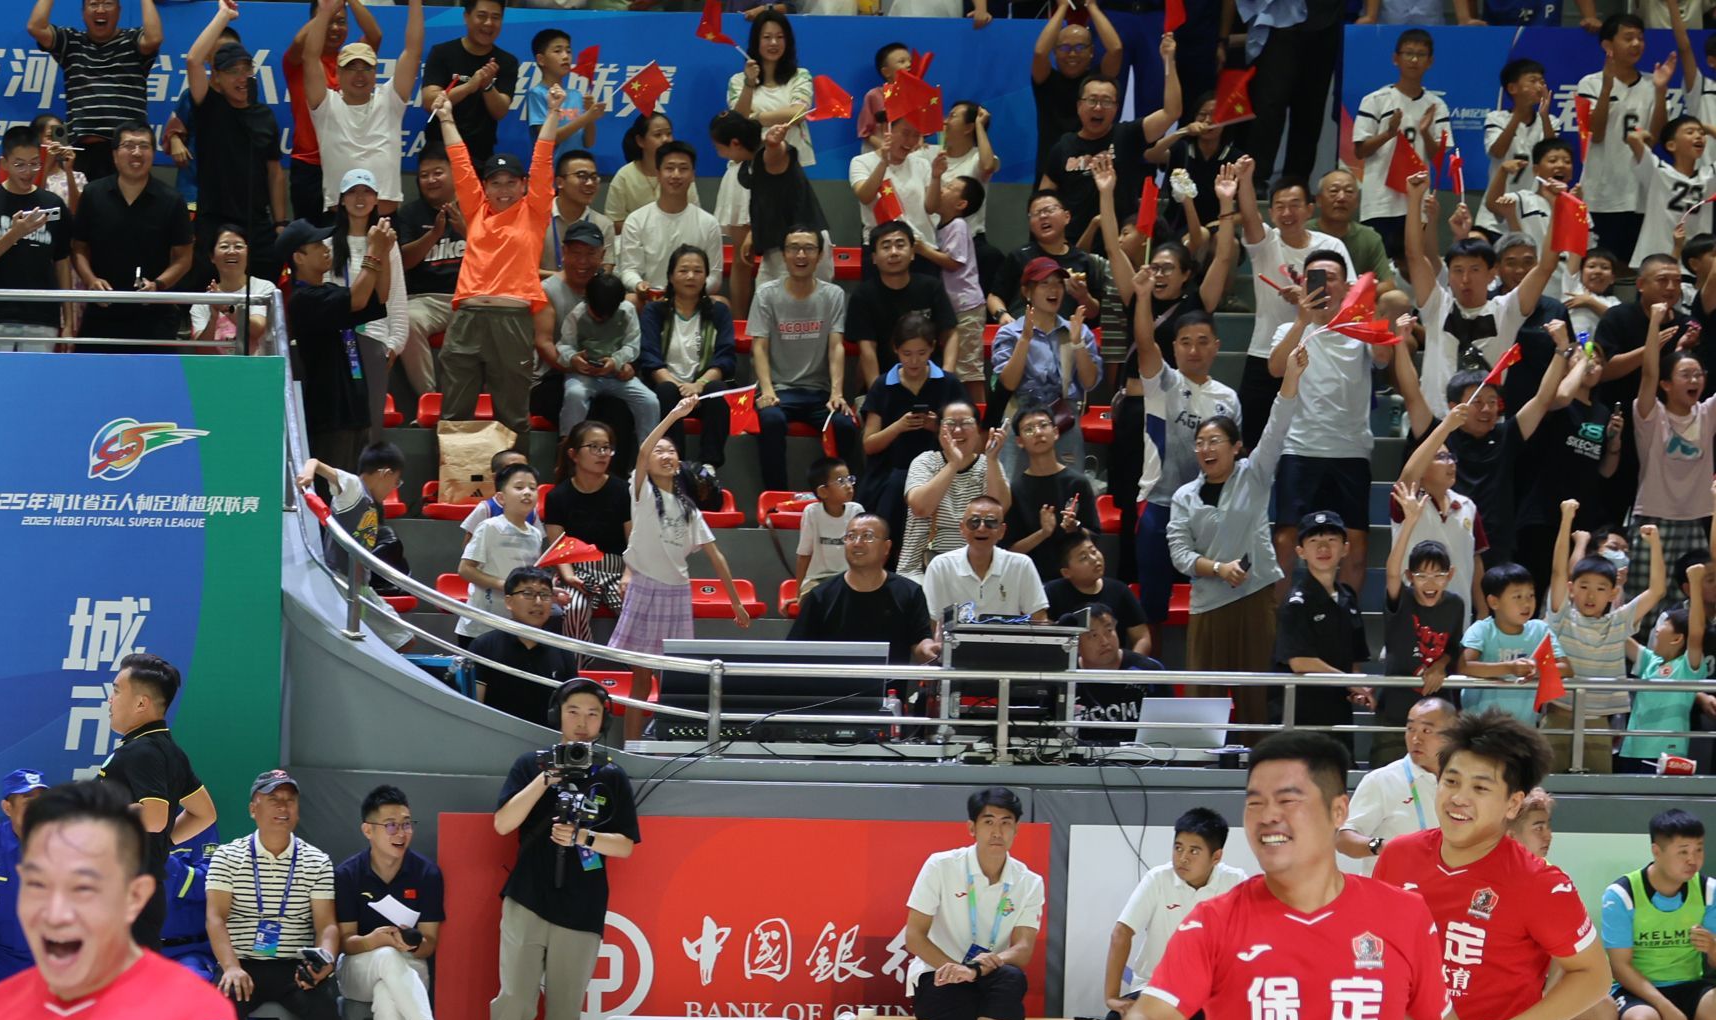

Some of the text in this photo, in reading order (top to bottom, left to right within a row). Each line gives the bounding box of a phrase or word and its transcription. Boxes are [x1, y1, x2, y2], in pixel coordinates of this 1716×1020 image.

[21, 516, 206, 529] 2025 HEBEI FUTSAL SUPER LEAGUE
[1445, 920, 1487, 965] 定
[684, 1001, 774, 1018] BANK
